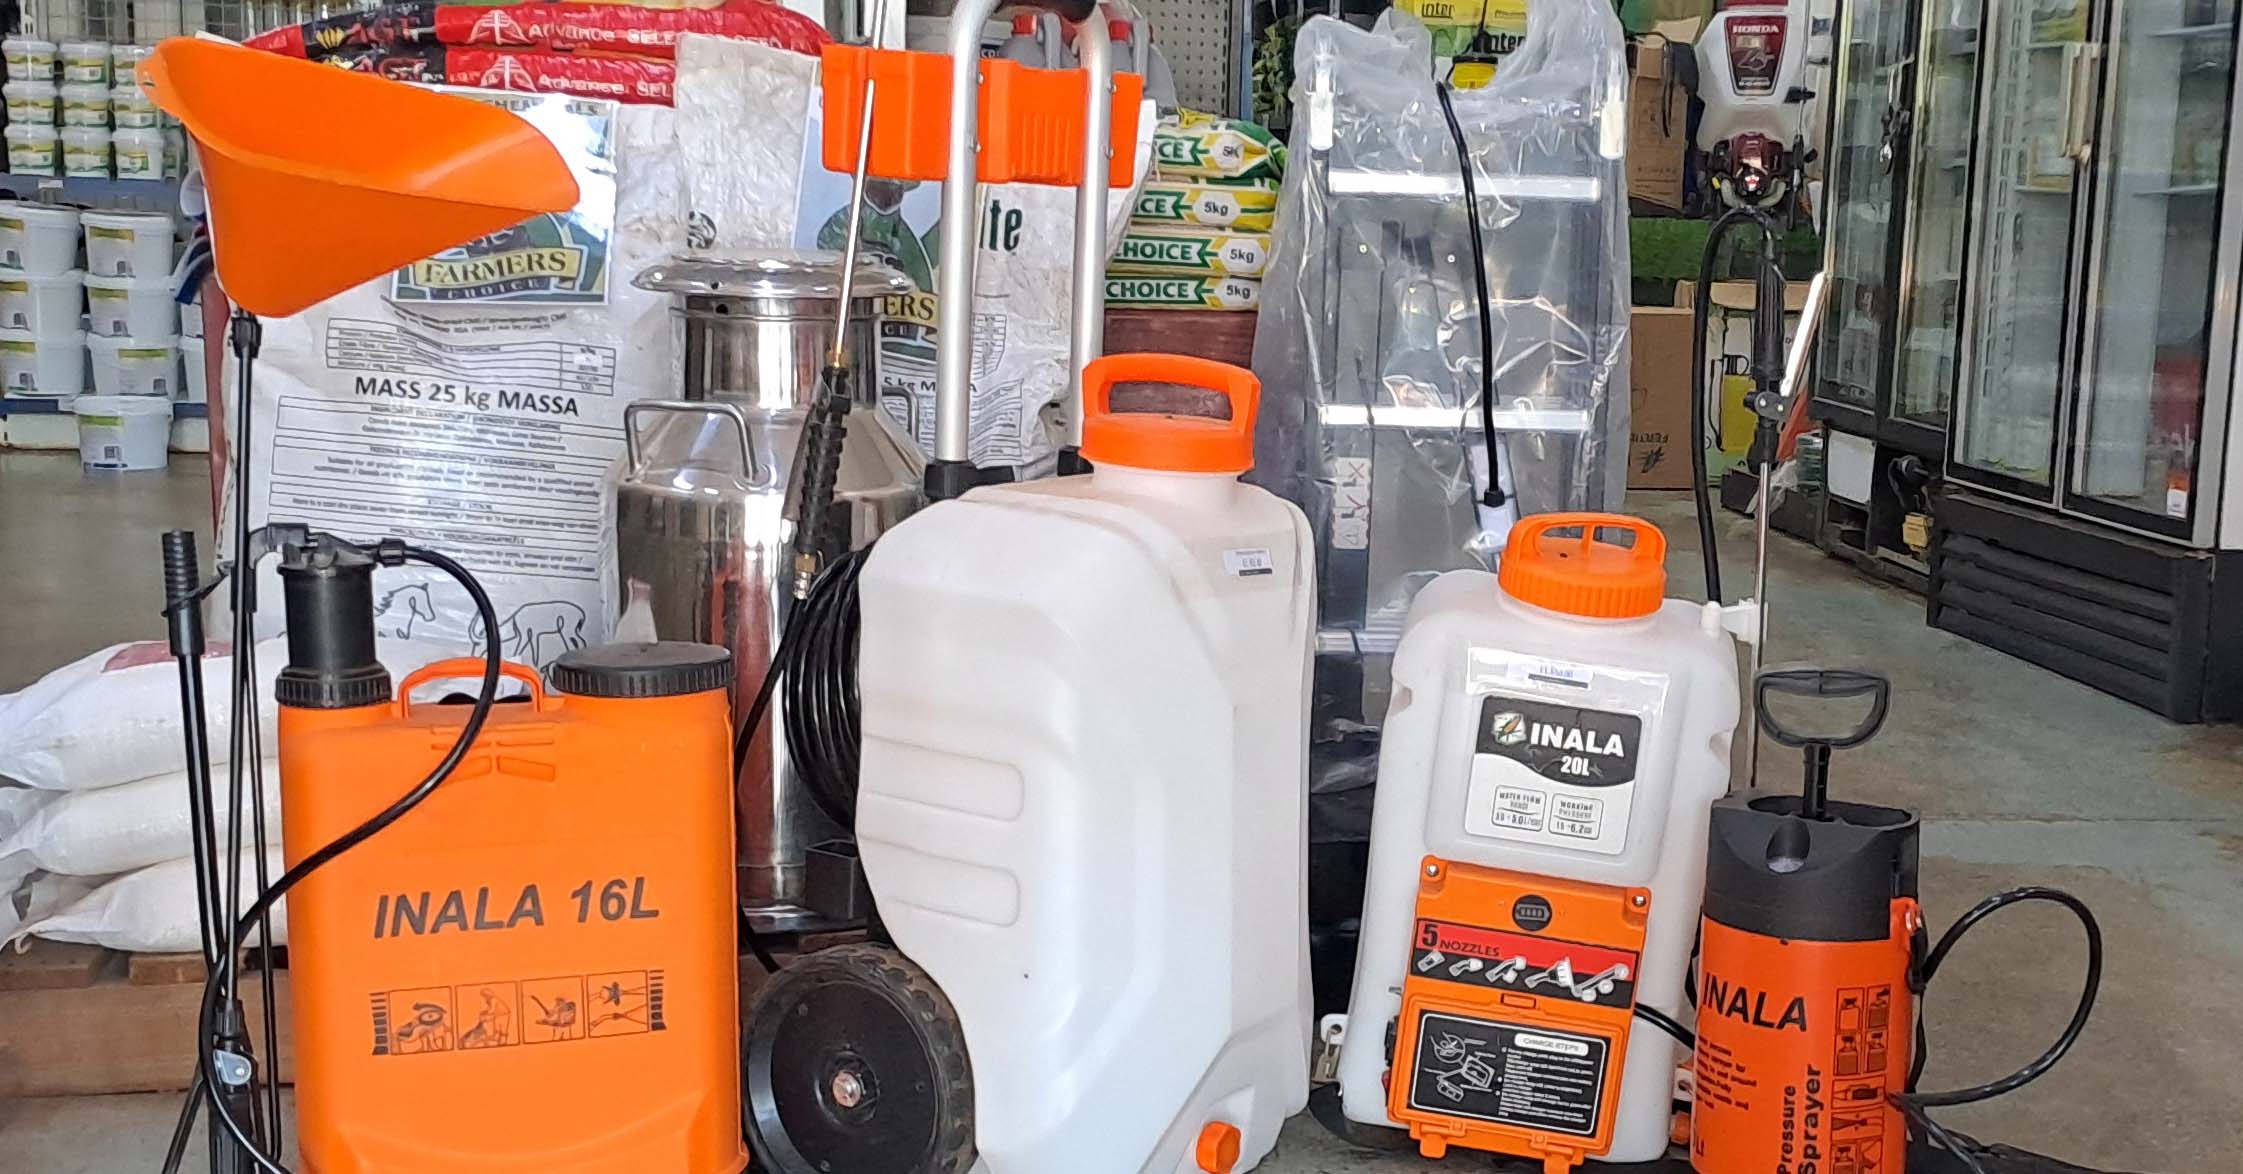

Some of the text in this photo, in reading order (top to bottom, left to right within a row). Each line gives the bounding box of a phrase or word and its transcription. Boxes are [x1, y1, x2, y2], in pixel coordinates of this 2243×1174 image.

[1732, 25, 1780, 33] HONDA
[1204, 201, 1229, 216] 5kg
[424, 251, 567, 284] FARMERS
[1230, 248, 1255, 264] 5kg
[447, 277, 543, 299] CHOICE
[1105, 281, 1251, 299] CHOICE 5kg
[355, 376, 580, 416] MASS 25 kg MASSA
[1530, 722, 1625, 758] INALA
[1560, 755, 1590, 776] 20L
[373, 876, 660, 939] INALA 16L
[1421, 923, 1500, 957] 5 NOZZLES
[1702, 972, 1807, 1032] INALA
[1776, 1085, 1797, 1174] Pressure
[1798, 1064, 1824, 1174] Sprayer
